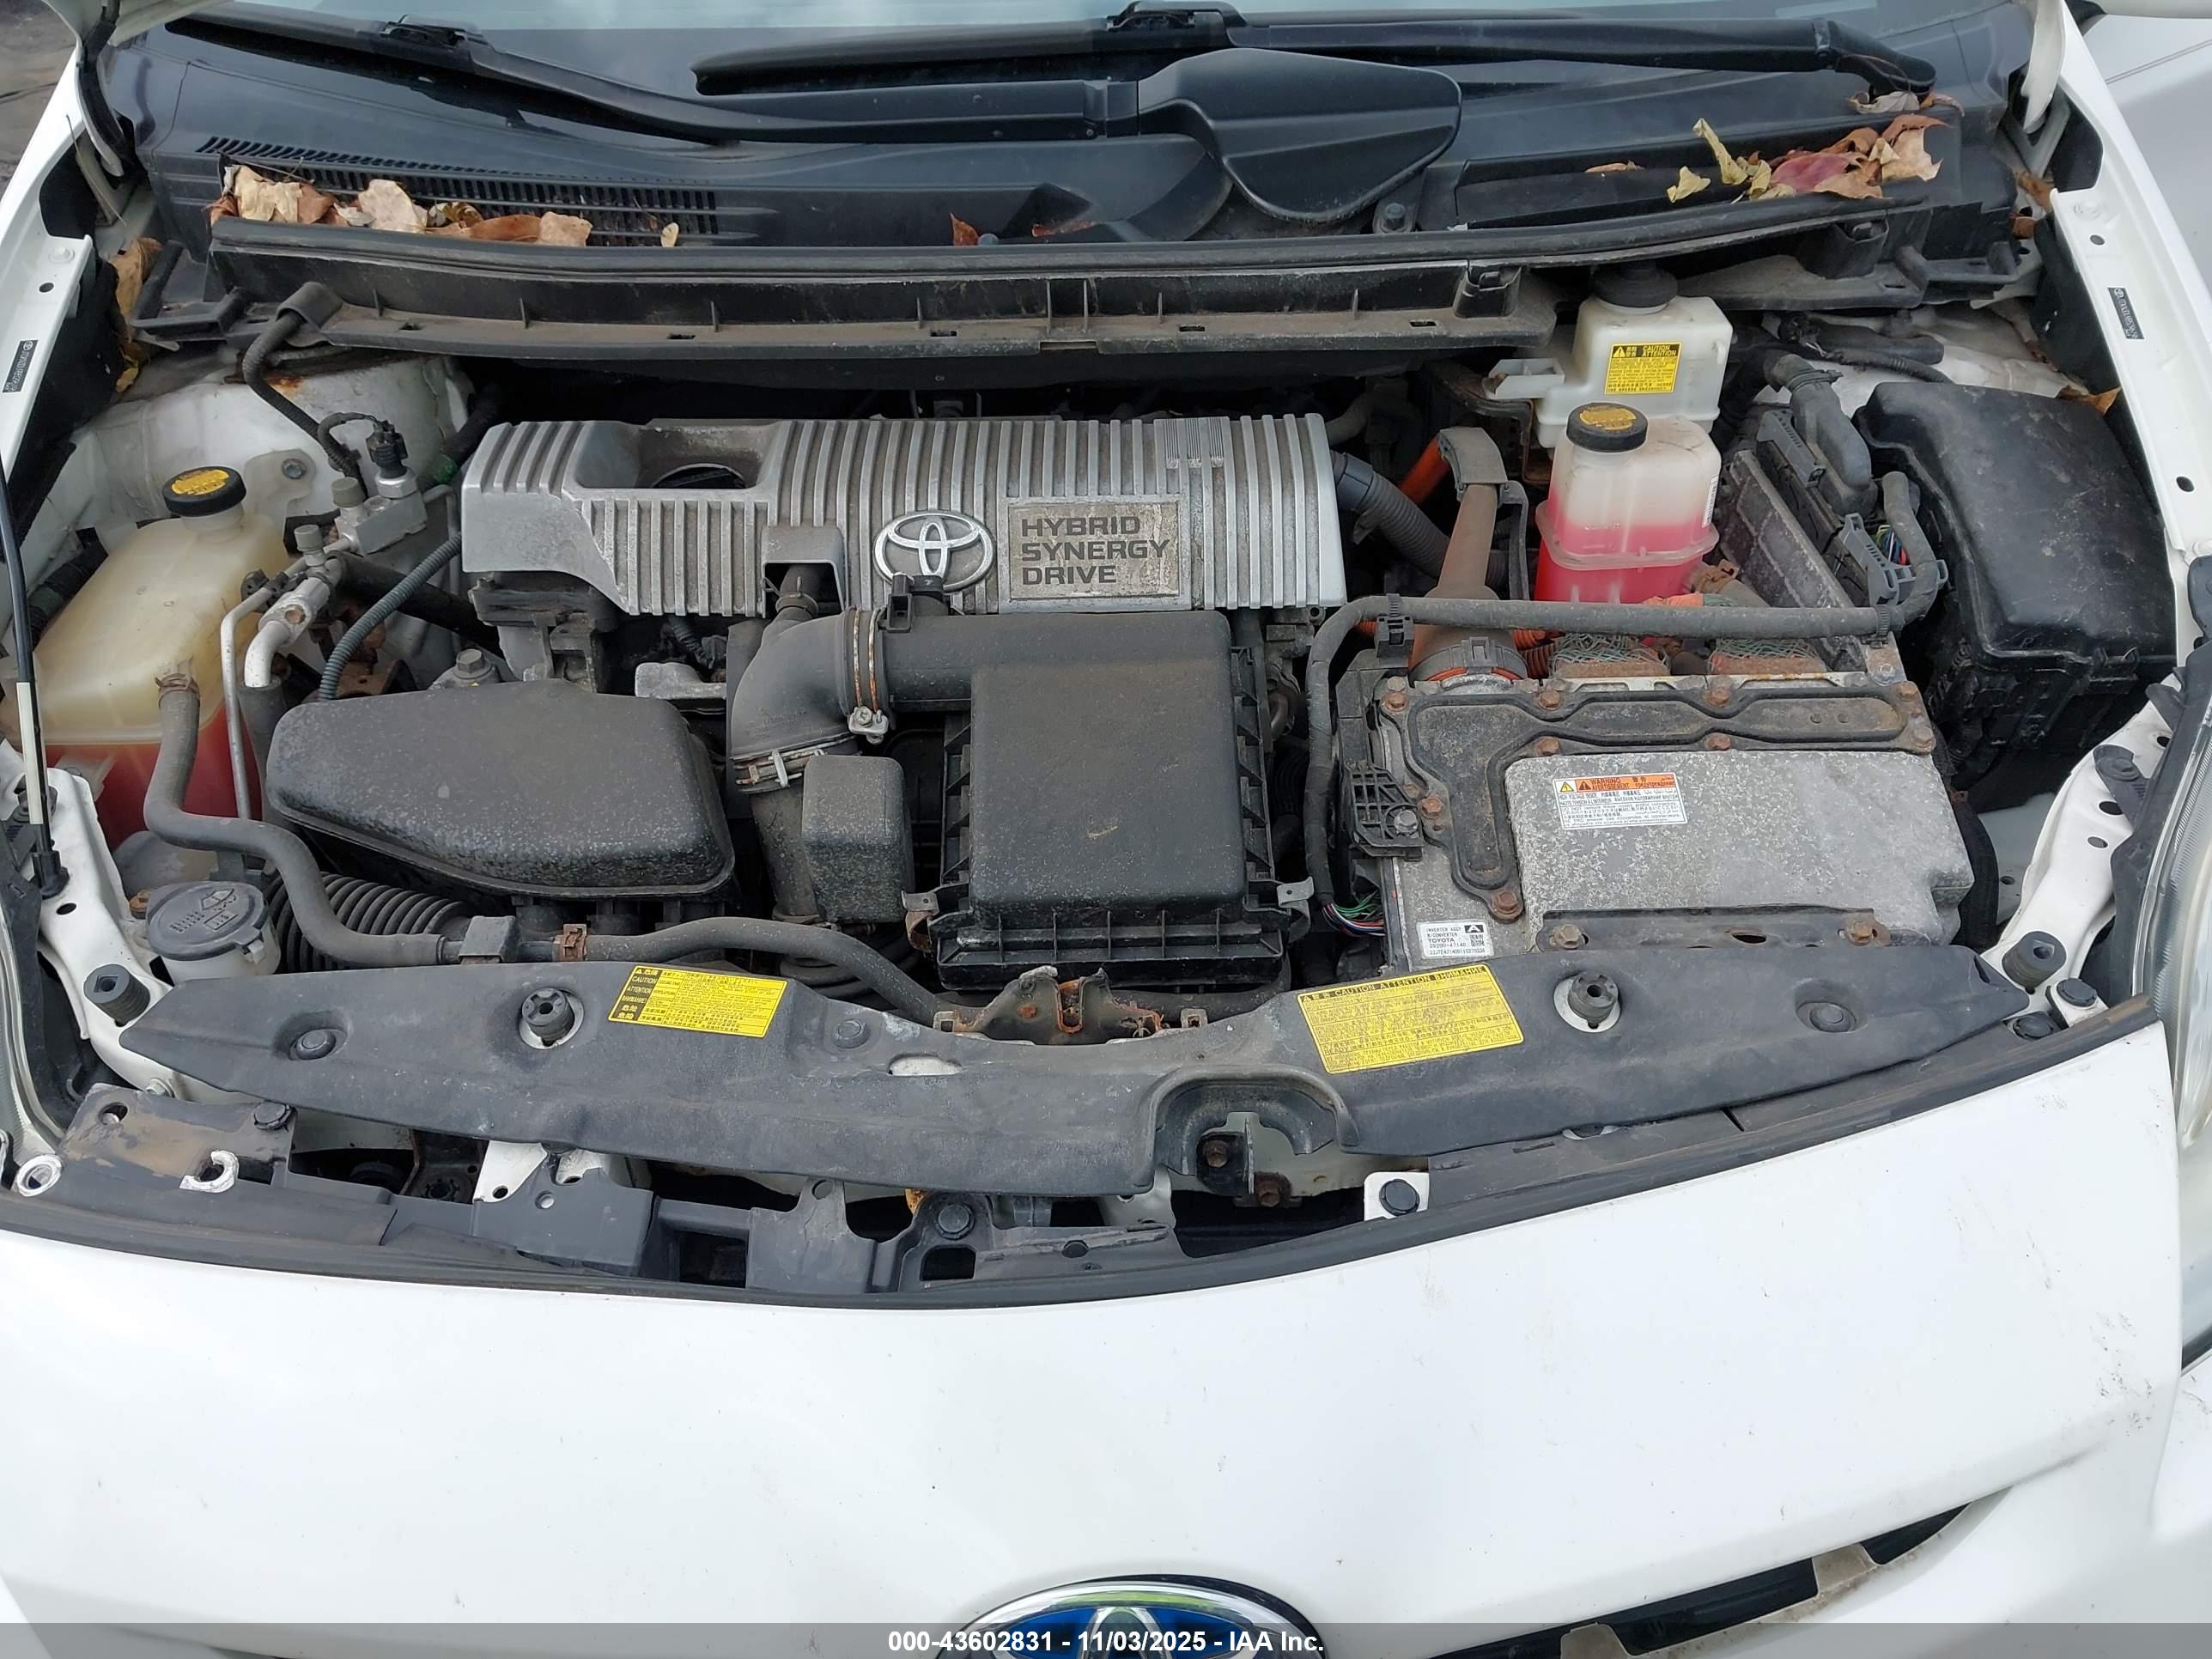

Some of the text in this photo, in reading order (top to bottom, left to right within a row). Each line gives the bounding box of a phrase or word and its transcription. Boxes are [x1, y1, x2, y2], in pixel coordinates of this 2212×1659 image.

[1022, 517, 1140, 537] HYBRID
[1022, 539, 1170, 562] SYNERGY
[1022, 565, 1116, 585] DRIVE
[626, 985, 652, 994] ATTENTION
[1334, 984, 1375, 996] CAUTION
[1378, 975, 1431, 989] ATTENTION
[1434, 966, 1485, 980] ВНИМАНИЕ
